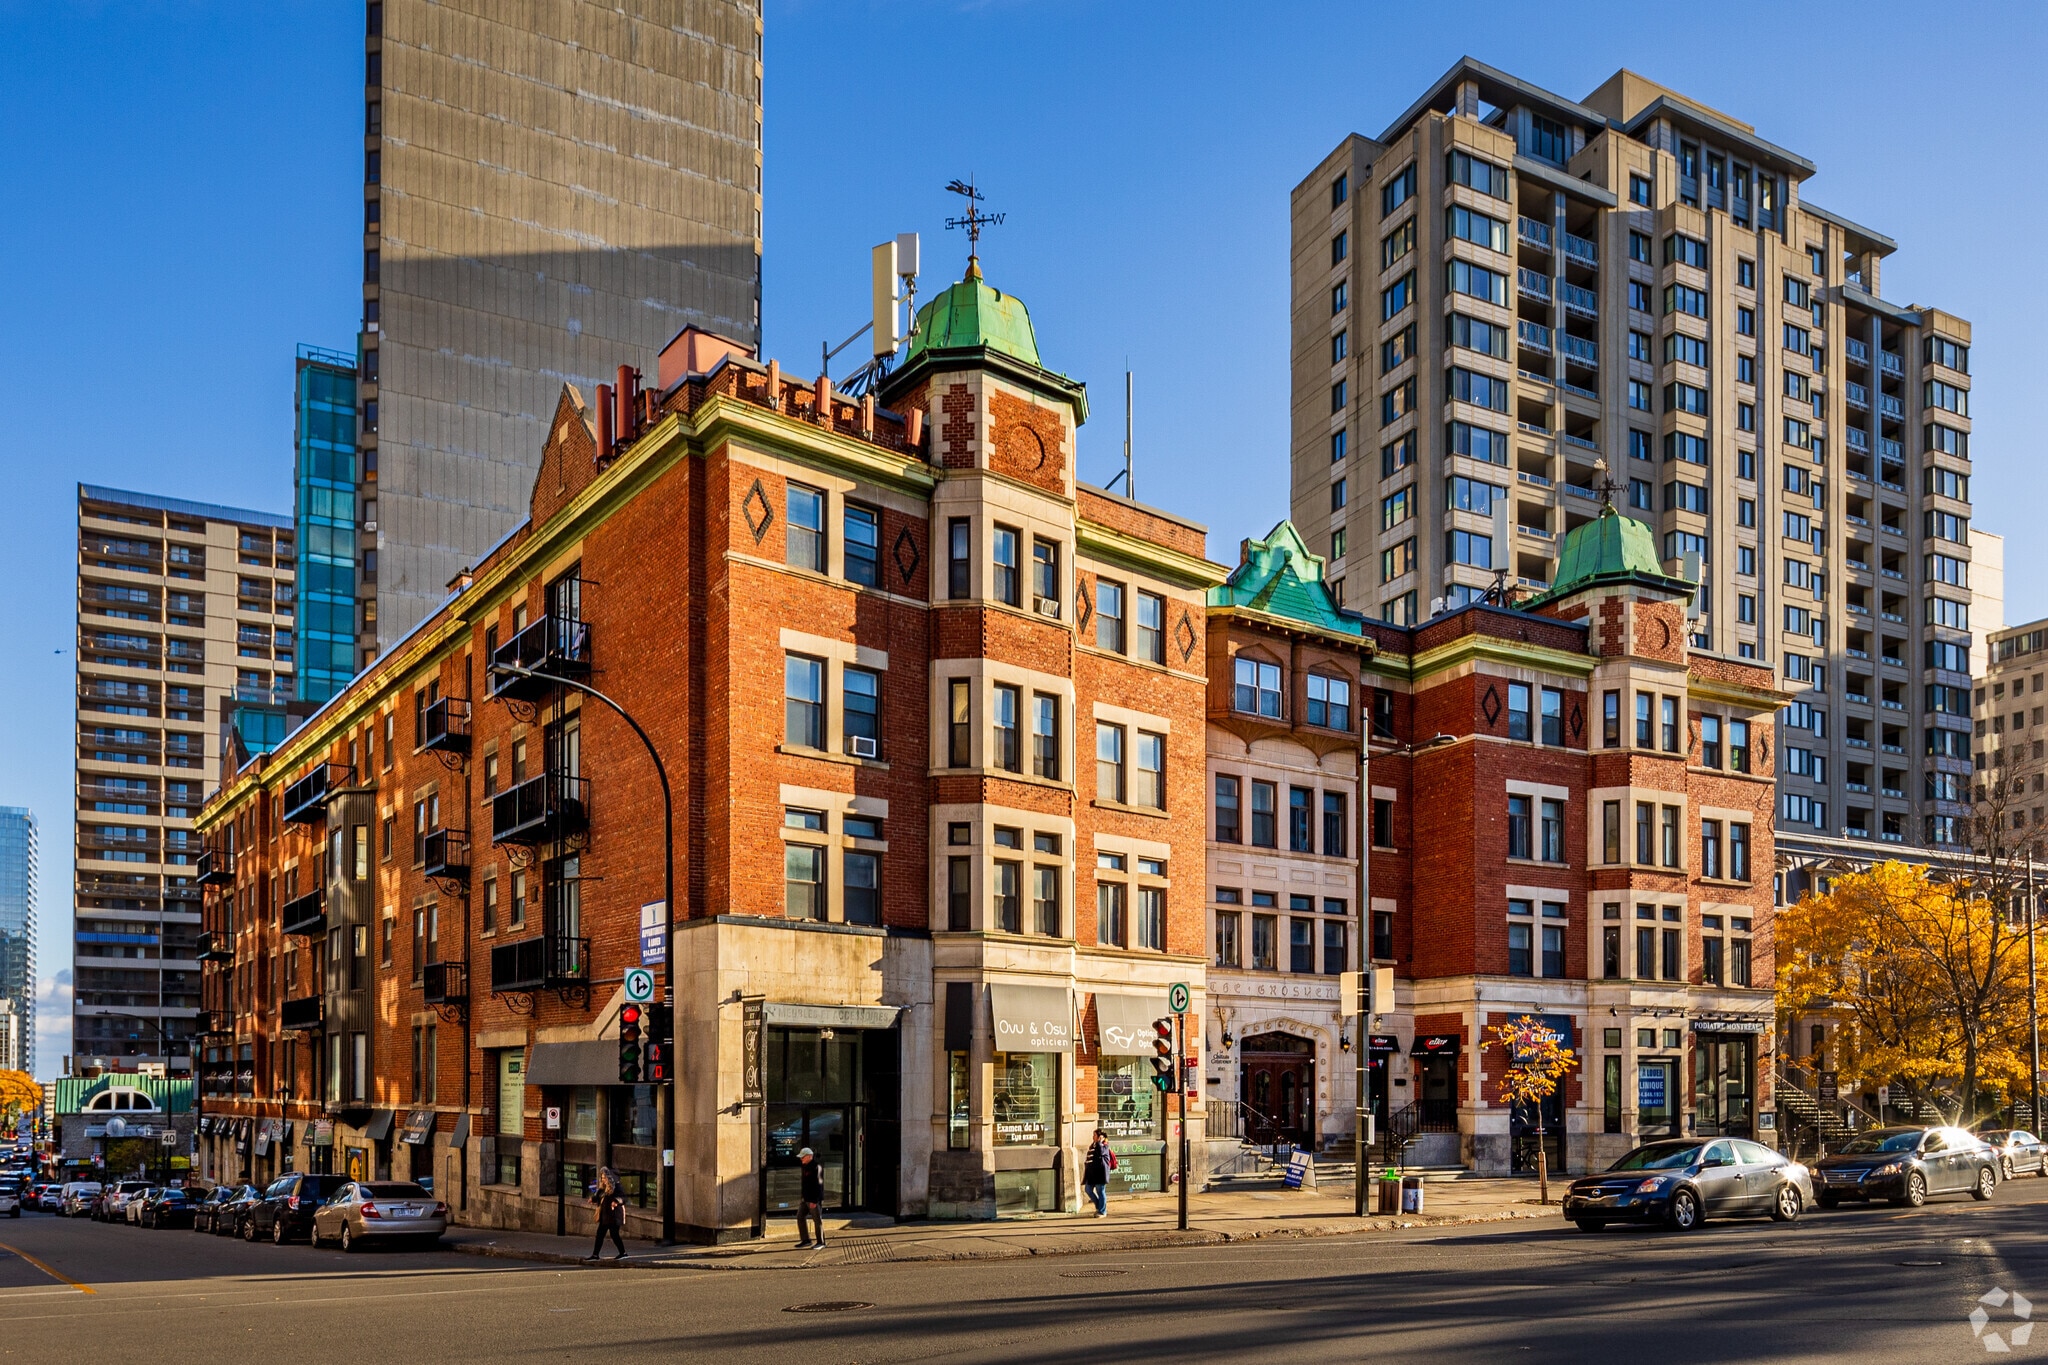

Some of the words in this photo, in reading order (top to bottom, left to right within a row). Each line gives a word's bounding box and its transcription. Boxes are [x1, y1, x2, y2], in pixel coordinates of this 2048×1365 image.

[991, 212, 1006, 226] W
[778, 1008, 818, 1019] MEUBLES
[833, 1009, 889, 1022] ACCESSOIRES
[999, 1020, 1024, 1034] Ovu
[1030, 1022, 1038, 1035] &
[1044, 1021, 1067, 1035] Osu
[1694, 1022, 1726, 1030] PODIATRE
[1031, 1037, 1068, 1047] opticien
[1639, 1082, 1664, 1090] LINIQUE
[997, 1123, 1022, 1132] Examen
[1023, 1122, 1032, 1131] de
[1033, 1122, 1040, 1131] la
[1103, 1120, 1127, 1129] Examen
[1129, 1119, 1137, 1129] de
[1138, 1118, 1145, 1127] la
[1011, 1134, 1021, 1142] Eye
[1116, 1129, 1127, 1137] Eye
[163, 1134, 175, 1143] 40
[1122, 1144, 1128, 1153] &
[1131, 1143, 1147, 1153] Osu
[1124, 1174, 1150, 1182] ÉPILATIO
